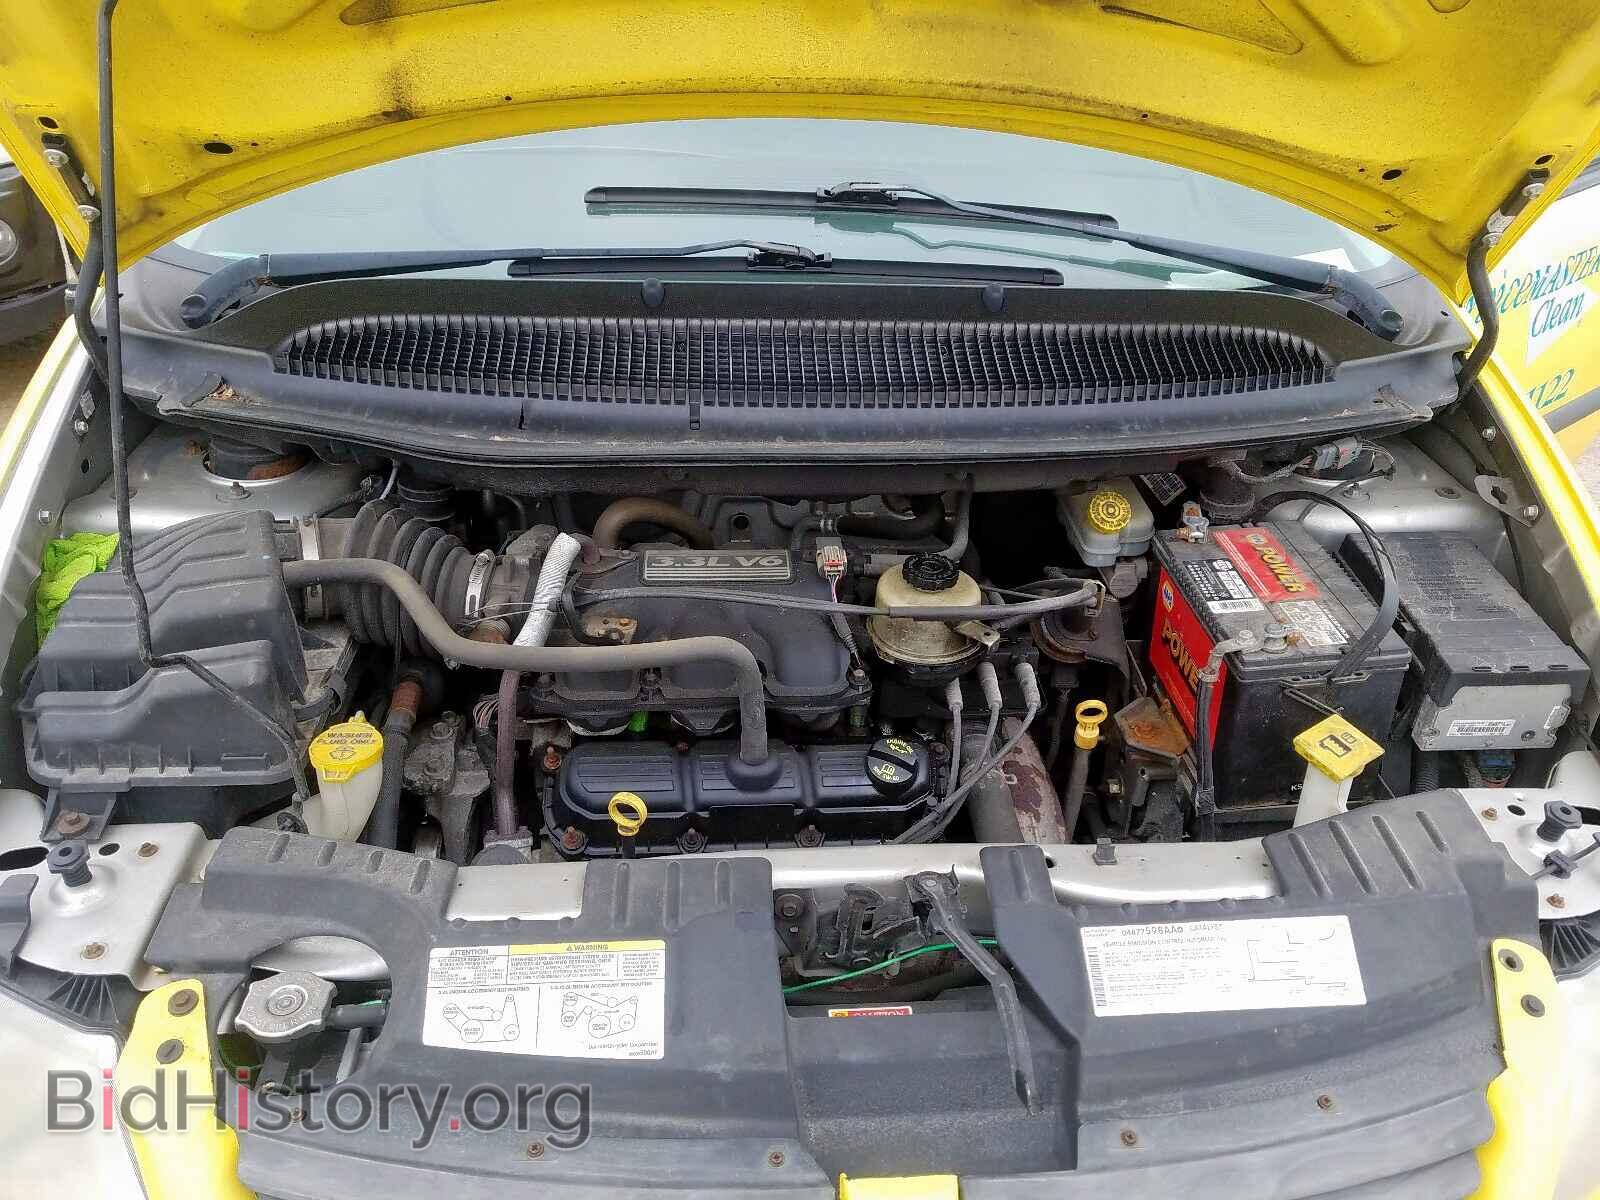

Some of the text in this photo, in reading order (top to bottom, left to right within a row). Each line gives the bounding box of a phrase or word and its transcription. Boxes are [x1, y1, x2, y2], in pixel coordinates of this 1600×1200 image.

[1531, 292, 1584, 337] Clean
[651, 555, 784, 567] 3.3L V6
[1255, 547, 1305, 593] POWER
[1160, 614, 1201, 691] POWE
[450, 949, 489, 957] ATTENTION
[574, 943, 609, 952] WARNING
